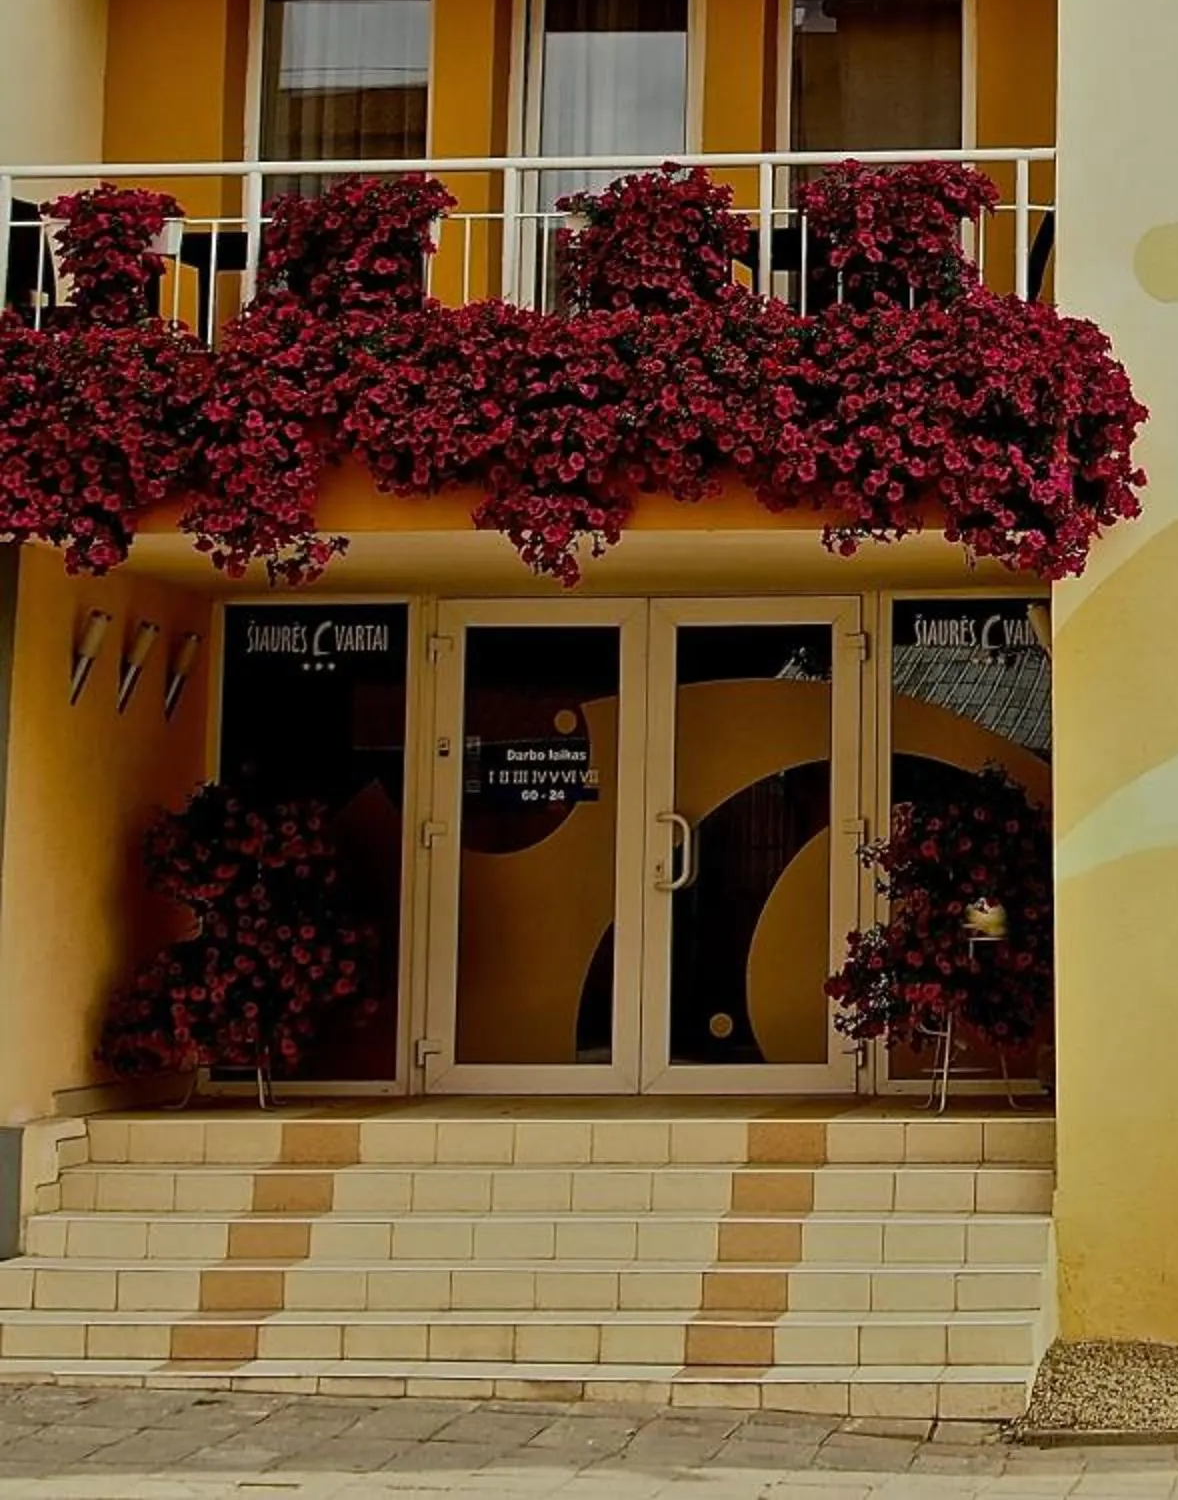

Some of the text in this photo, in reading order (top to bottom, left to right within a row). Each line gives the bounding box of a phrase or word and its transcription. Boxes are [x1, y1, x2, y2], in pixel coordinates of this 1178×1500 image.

[334, 624, 390, 653] VARTAI
[914, 613, 977, 648] ŠIAURĖS
[507, 749, 545, 762] Darbo
[512, 769, 528, 785] III
[531, 769, 547, 785] IV
[549, 769, 560, 785] V
[561, 769, 577, 785] VI
[549, 789, 565, 801] 24
